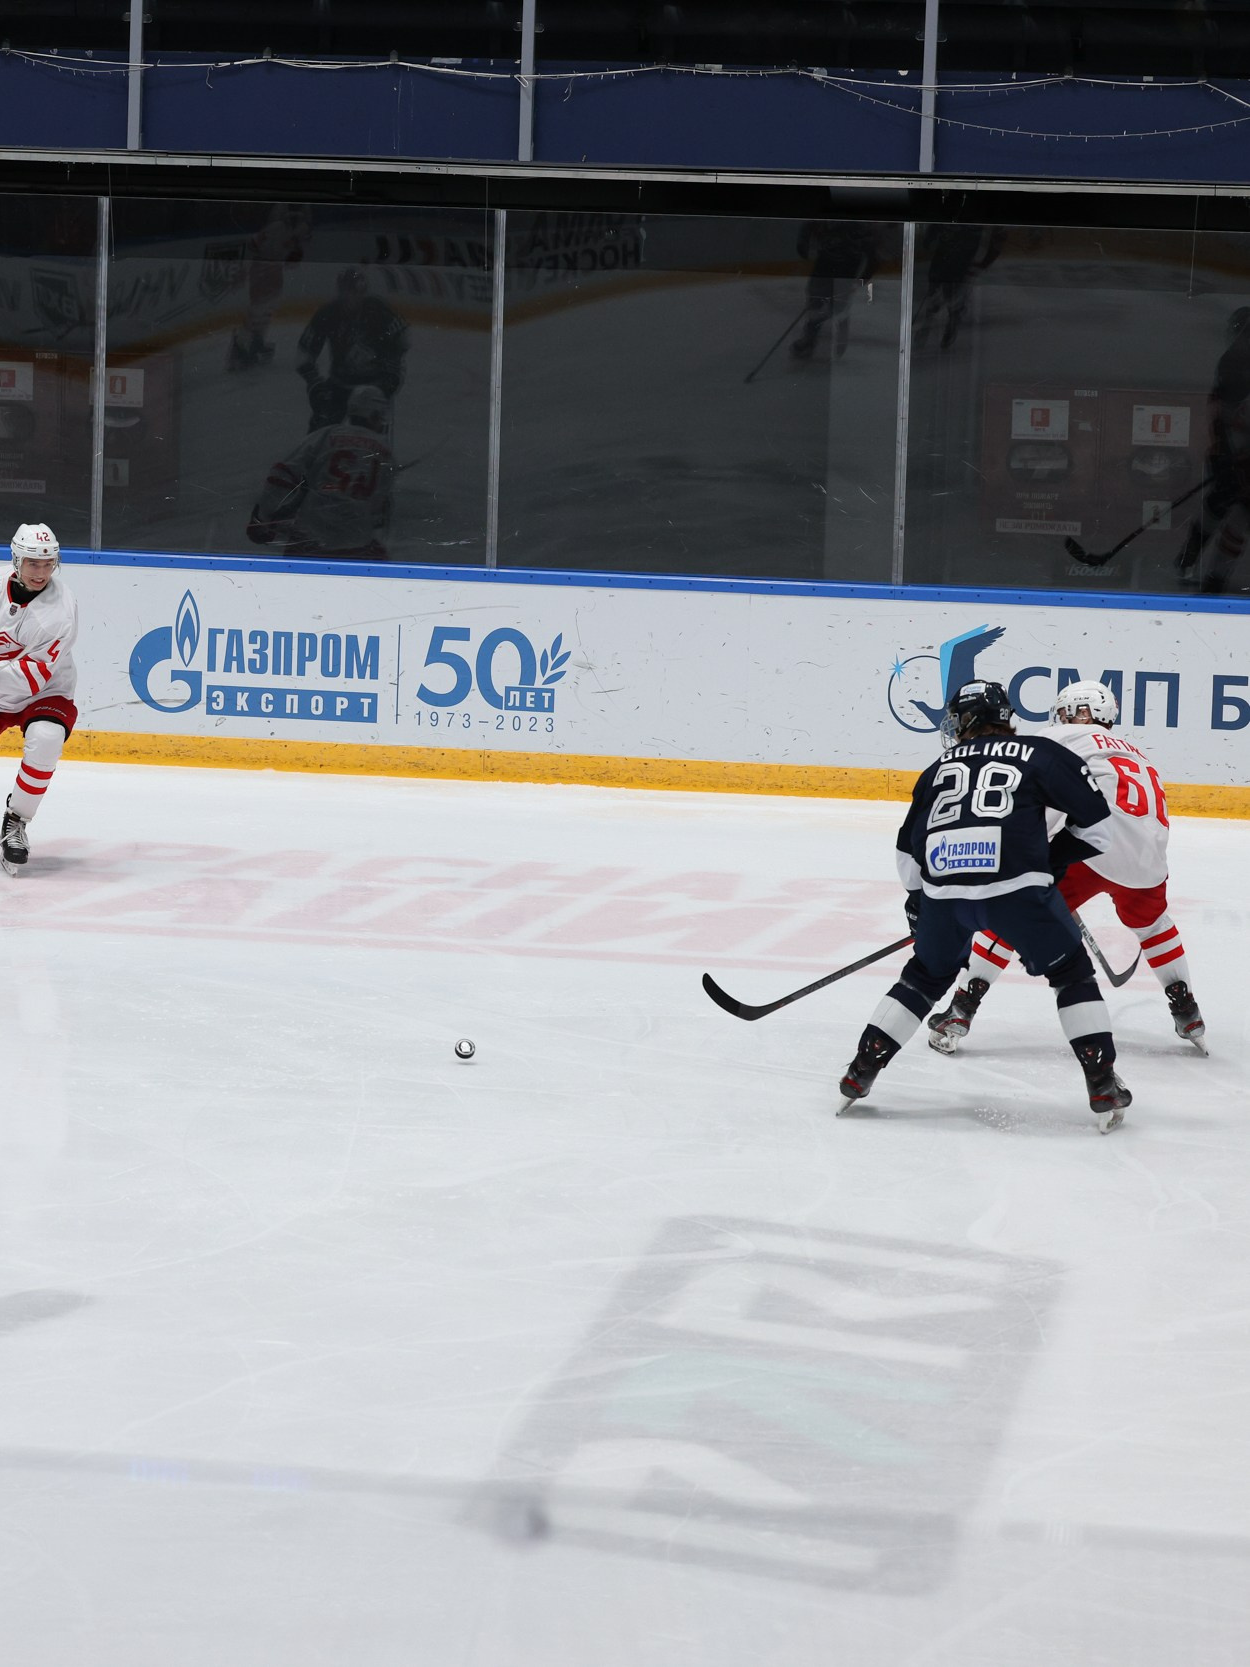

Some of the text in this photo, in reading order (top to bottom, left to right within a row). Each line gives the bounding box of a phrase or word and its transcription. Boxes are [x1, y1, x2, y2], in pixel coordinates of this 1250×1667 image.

[36, 532, 50, 542] 42
[207, 628, 379, 681] ГАЗПРОМ
[416, 626, 537, 709] 50
[211, 689, 372, 717] ЭКСПОРТ
[508, 690, 551, 709] ЛЕТ
[926, 761, 1022, 831] 28
[947, 841, 996, 857] ГАЗПРОМ
[948, 859, 995, 869] ЭКСПОРТ
